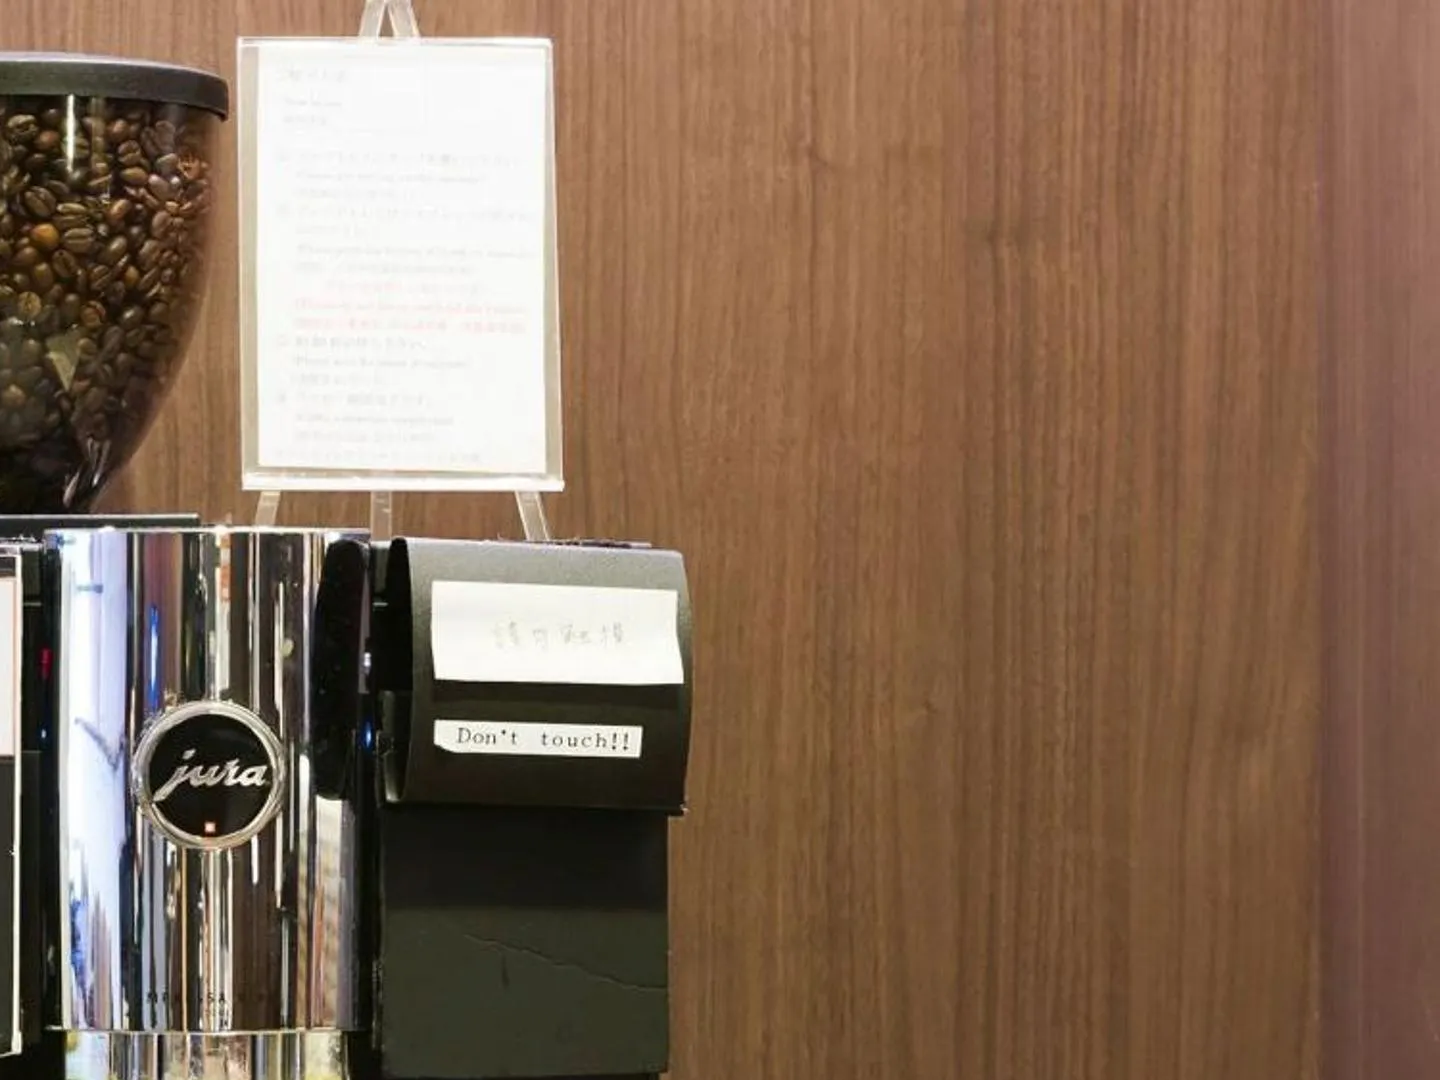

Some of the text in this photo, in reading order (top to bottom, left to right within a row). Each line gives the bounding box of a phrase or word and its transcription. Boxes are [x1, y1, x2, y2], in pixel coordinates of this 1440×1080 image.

[457, 727, 630, 751] Don't touch!!
[152, 748, 268, 803] jura
